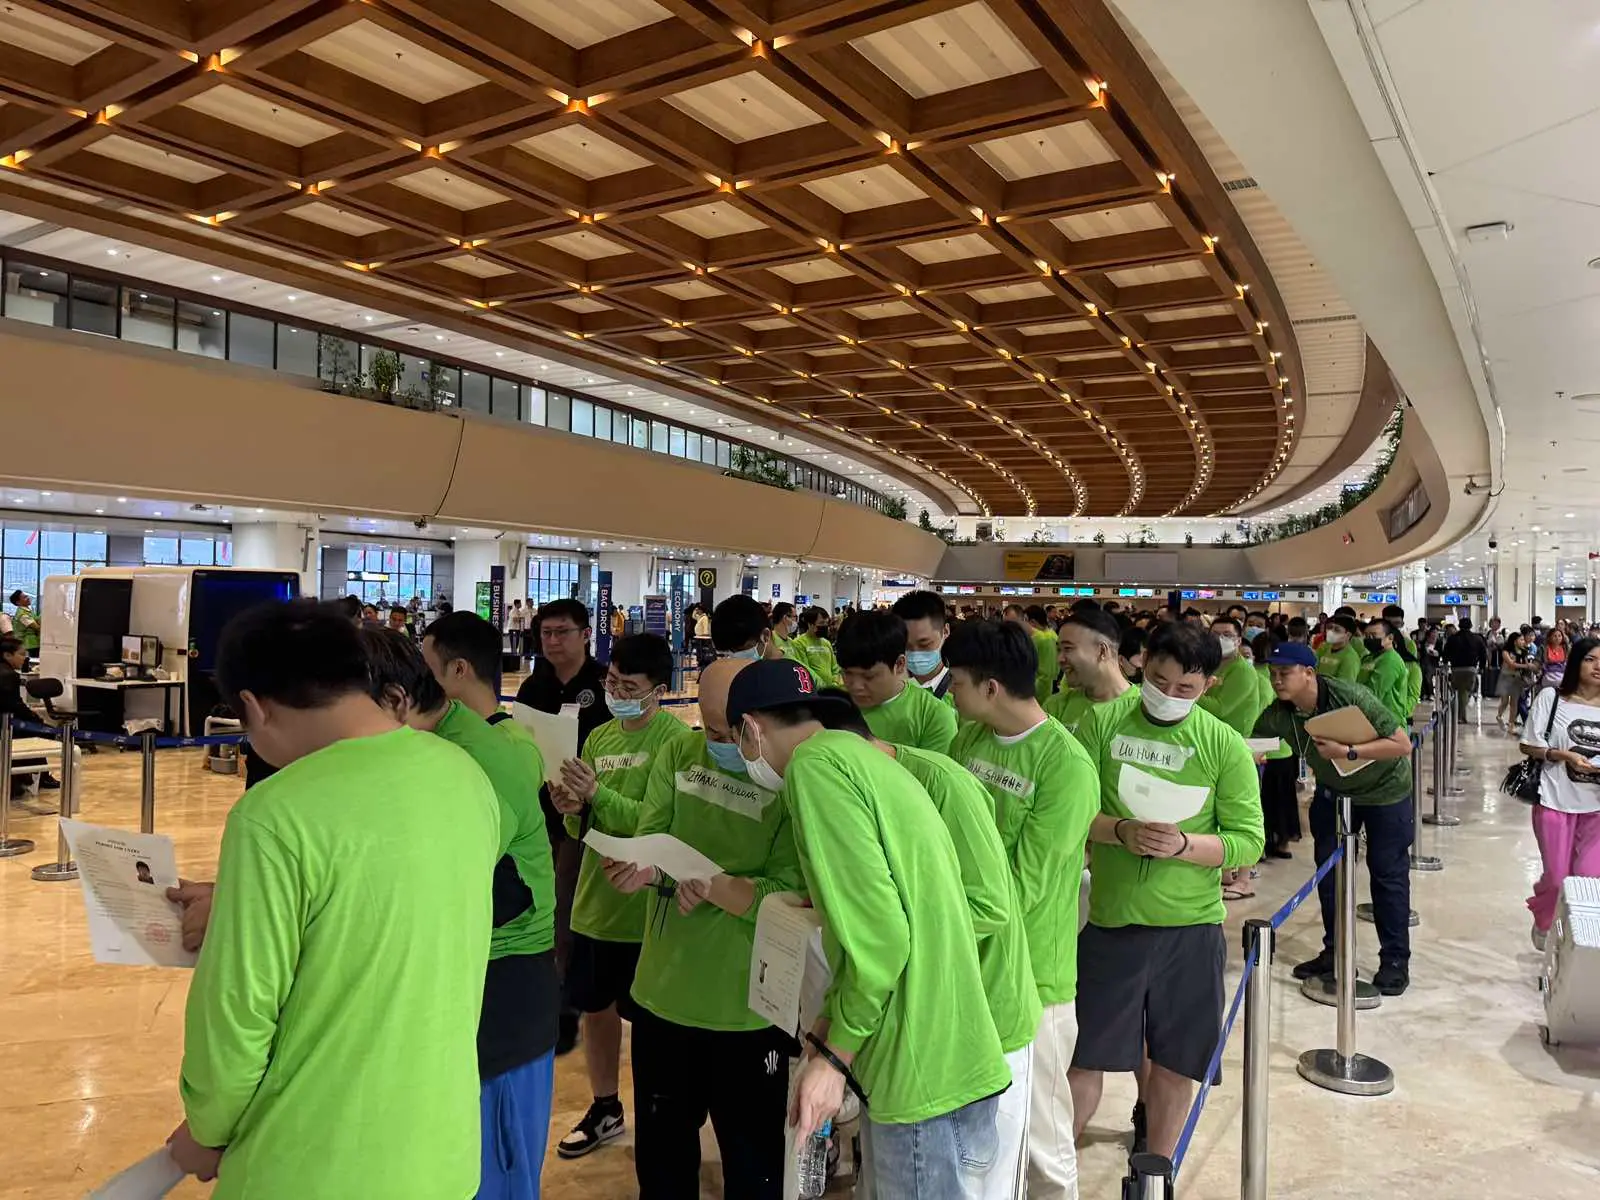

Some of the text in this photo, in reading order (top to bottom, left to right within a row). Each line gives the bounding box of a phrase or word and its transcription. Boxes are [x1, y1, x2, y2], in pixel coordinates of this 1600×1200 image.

[492, 585, 500, 629] BUSINES
[600, 589, 608, 635] BAG DROP
[793, 666, 813, 694] B
[1119, 741, 1134, 757] LIU
